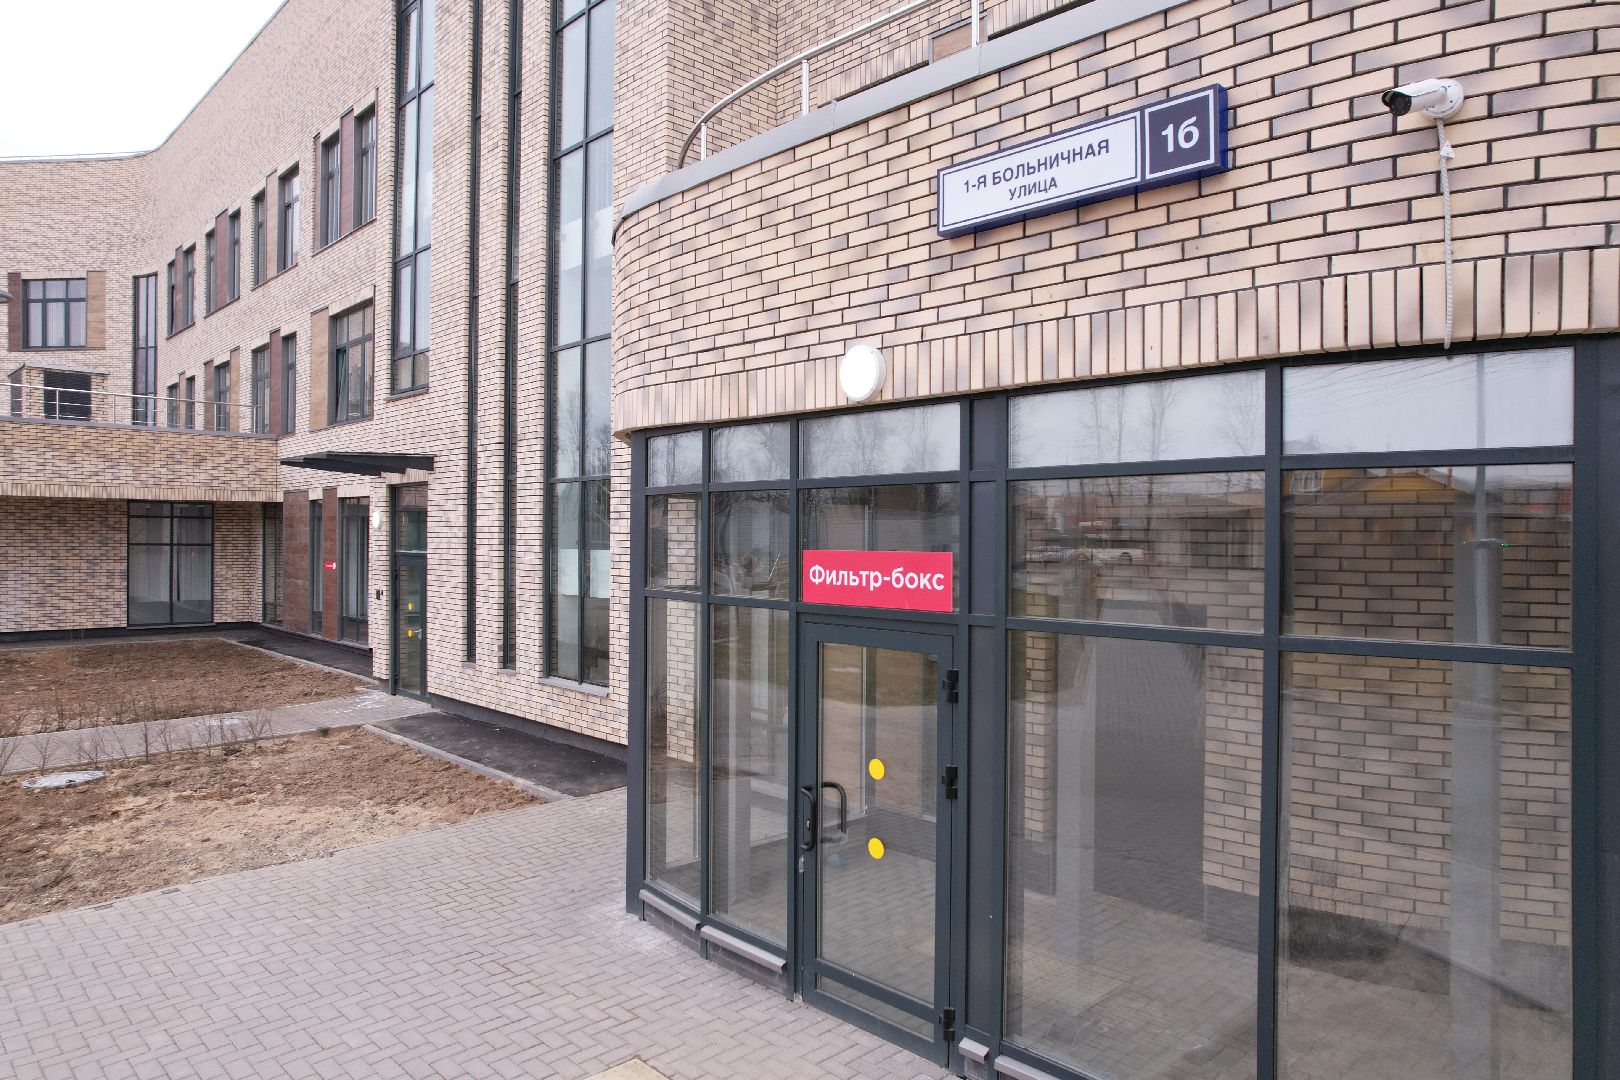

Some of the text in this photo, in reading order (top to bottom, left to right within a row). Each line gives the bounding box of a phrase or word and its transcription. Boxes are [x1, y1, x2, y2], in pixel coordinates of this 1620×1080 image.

[963, 138, 1110, 194] 1-Я БОЛЬНИЧНАЯ
[1008, 177, 1058, 201] УЛИЦА
[809, 564, 945, 591] Фильтр-бокс
